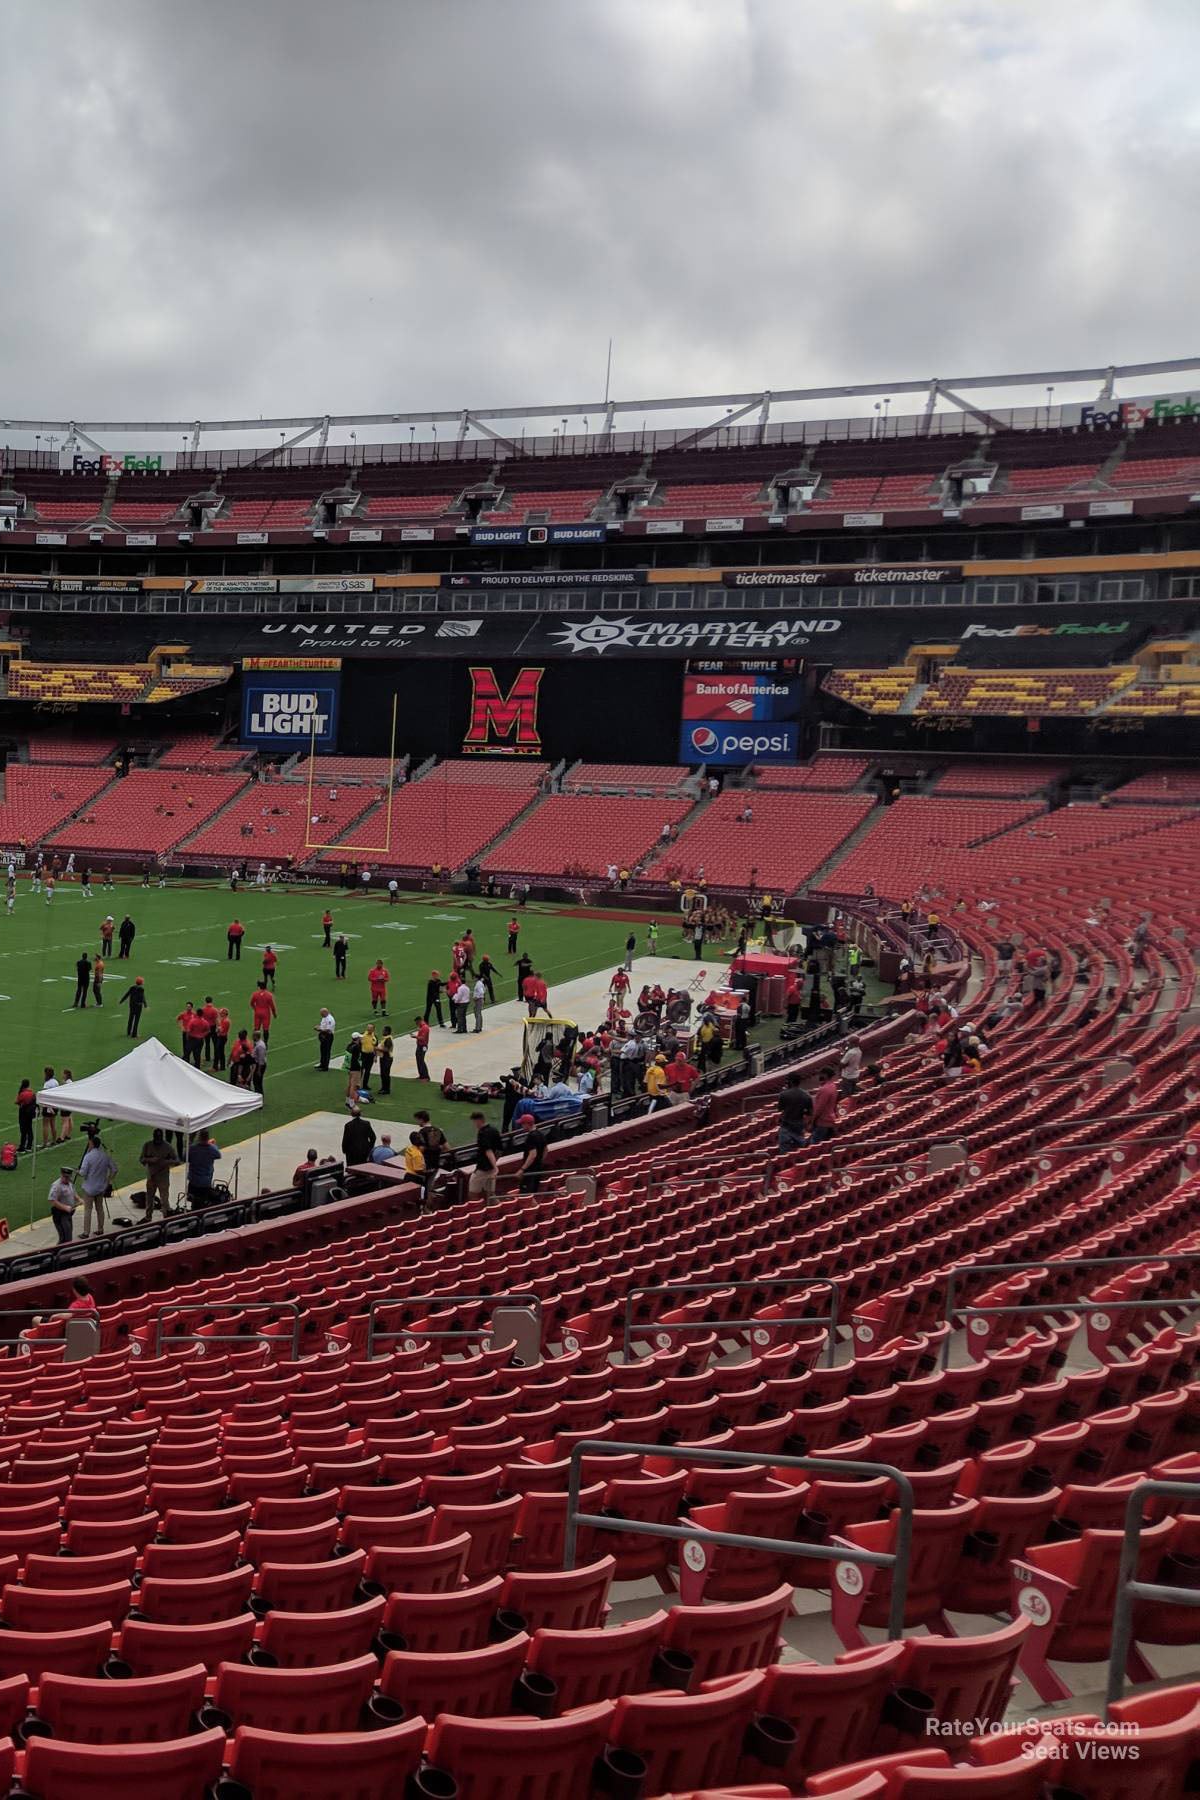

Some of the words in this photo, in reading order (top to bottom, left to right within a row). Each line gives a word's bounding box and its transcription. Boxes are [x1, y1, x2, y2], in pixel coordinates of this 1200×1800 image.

[72, 455, 162, 472] FedExField
[475, 532, 494, 541] BUD
[495, 531, 522, 540] LIGHT
[553, 531, 573, 539] BUD
[574, 529, 602, 539] LIGHT
[481, 576, 509, 584] PROUD
[510, 576, 521, 584] TO
[522, 575, 557, 584] DELIVER
[557, 575, 575, 583] FOR
[575, 575, 590, 583] THE
[735, 572, 821, 585] ticketmaster
[854, 569, 944, 583] ticketmaster
[349, 580, 366, 589] sas
[262, 624, 426, 636] UNITED
[648, 619, 842, 635] MARYLAND
[960, 622, 1130, 639] FedExField
[299, 638, 358, 648] Proud
[360, 639, 381, 648] to
[385, 638, 413, 648] fly
[698, 661, 724, 670] FEAR
[741, 661, 778, 671] TURTLE
[696, 684, 727, 694] Bank
[727, 683, 740, 694] of
[741, 684, 790, 695] America
[262, 693, 318, 713] BUD
[250, 713, 328, 734] LIGHT
[722, 733, 790, 755] pepsi
